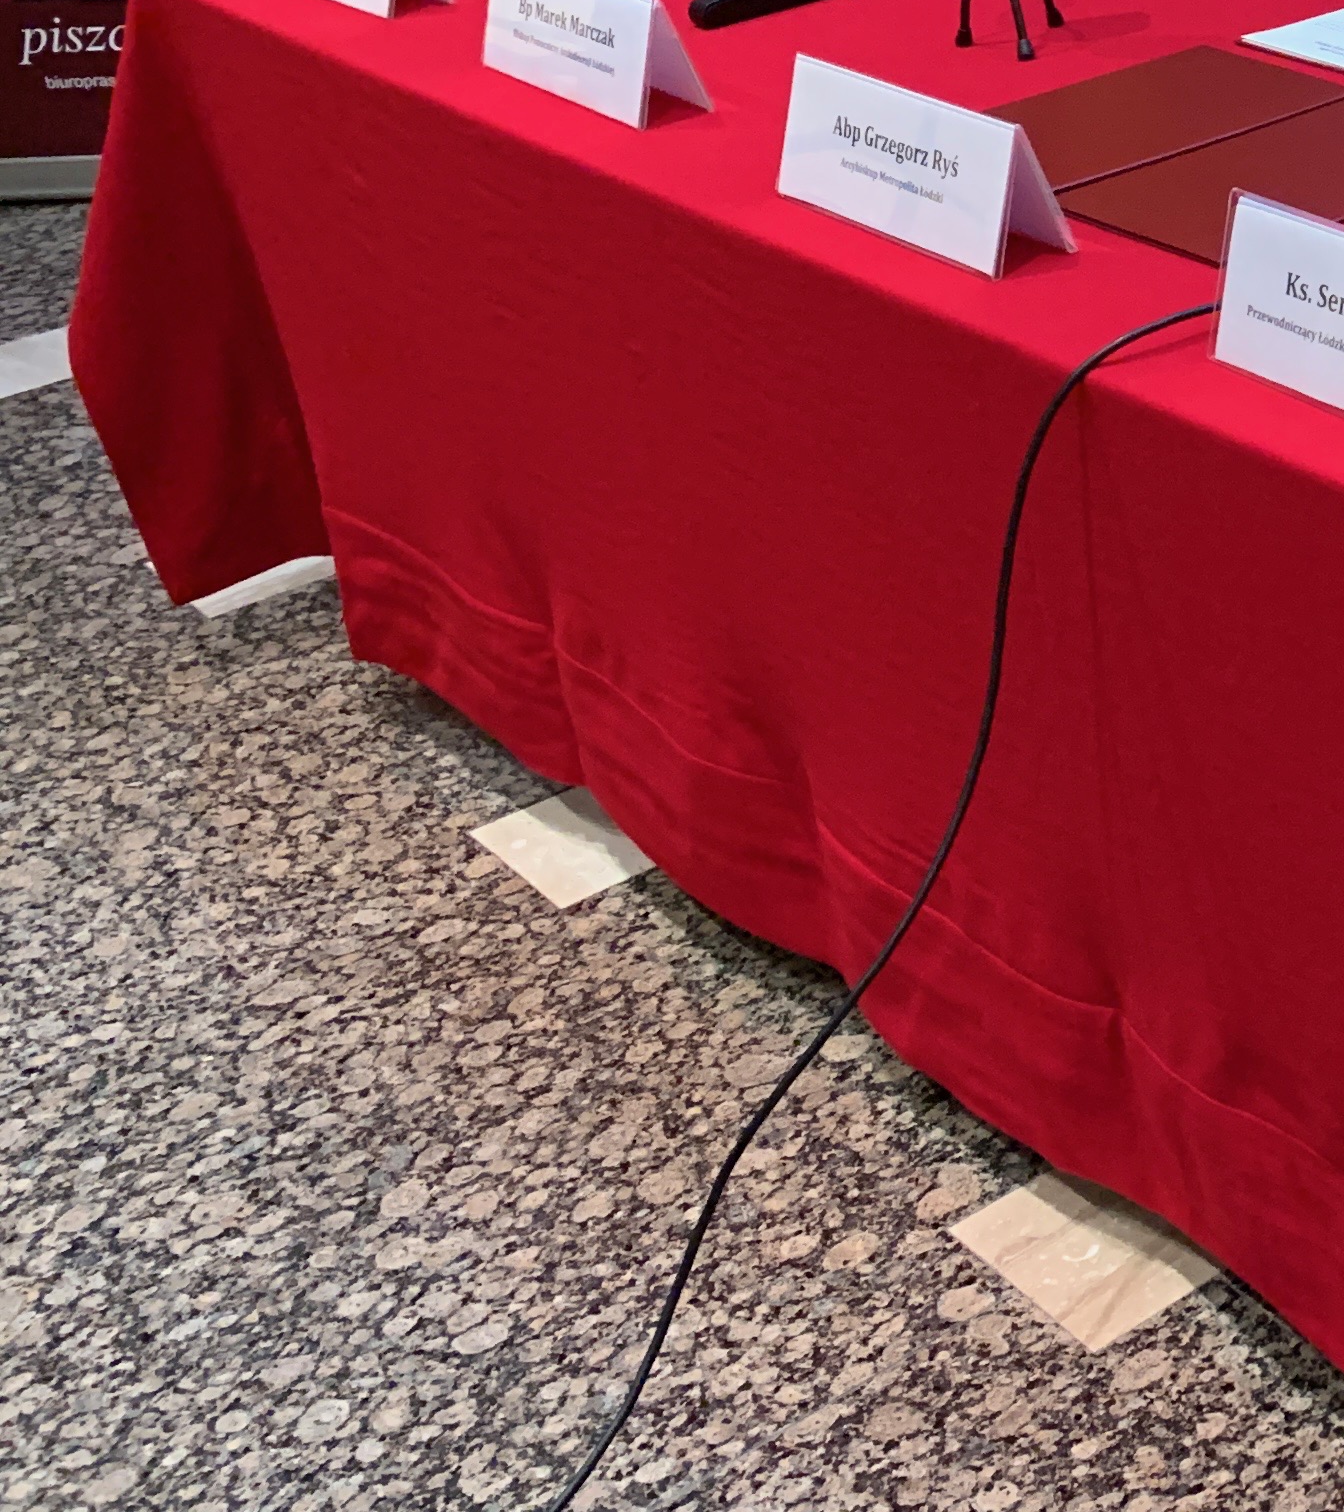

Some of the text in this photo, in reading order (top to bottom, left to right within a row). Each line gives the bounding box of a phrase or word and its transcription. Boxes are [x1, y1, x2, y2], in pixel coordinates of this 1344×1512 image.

[535, 1, 567, 30] Marek
[569, 15, 615, 49] Marczak
[833, 115, 959, 179] Abp Grzegorz Ryś
[1285, 272, 1312, 304] Ks.
[1246, 304, 1317, 344] Przewodniczący
